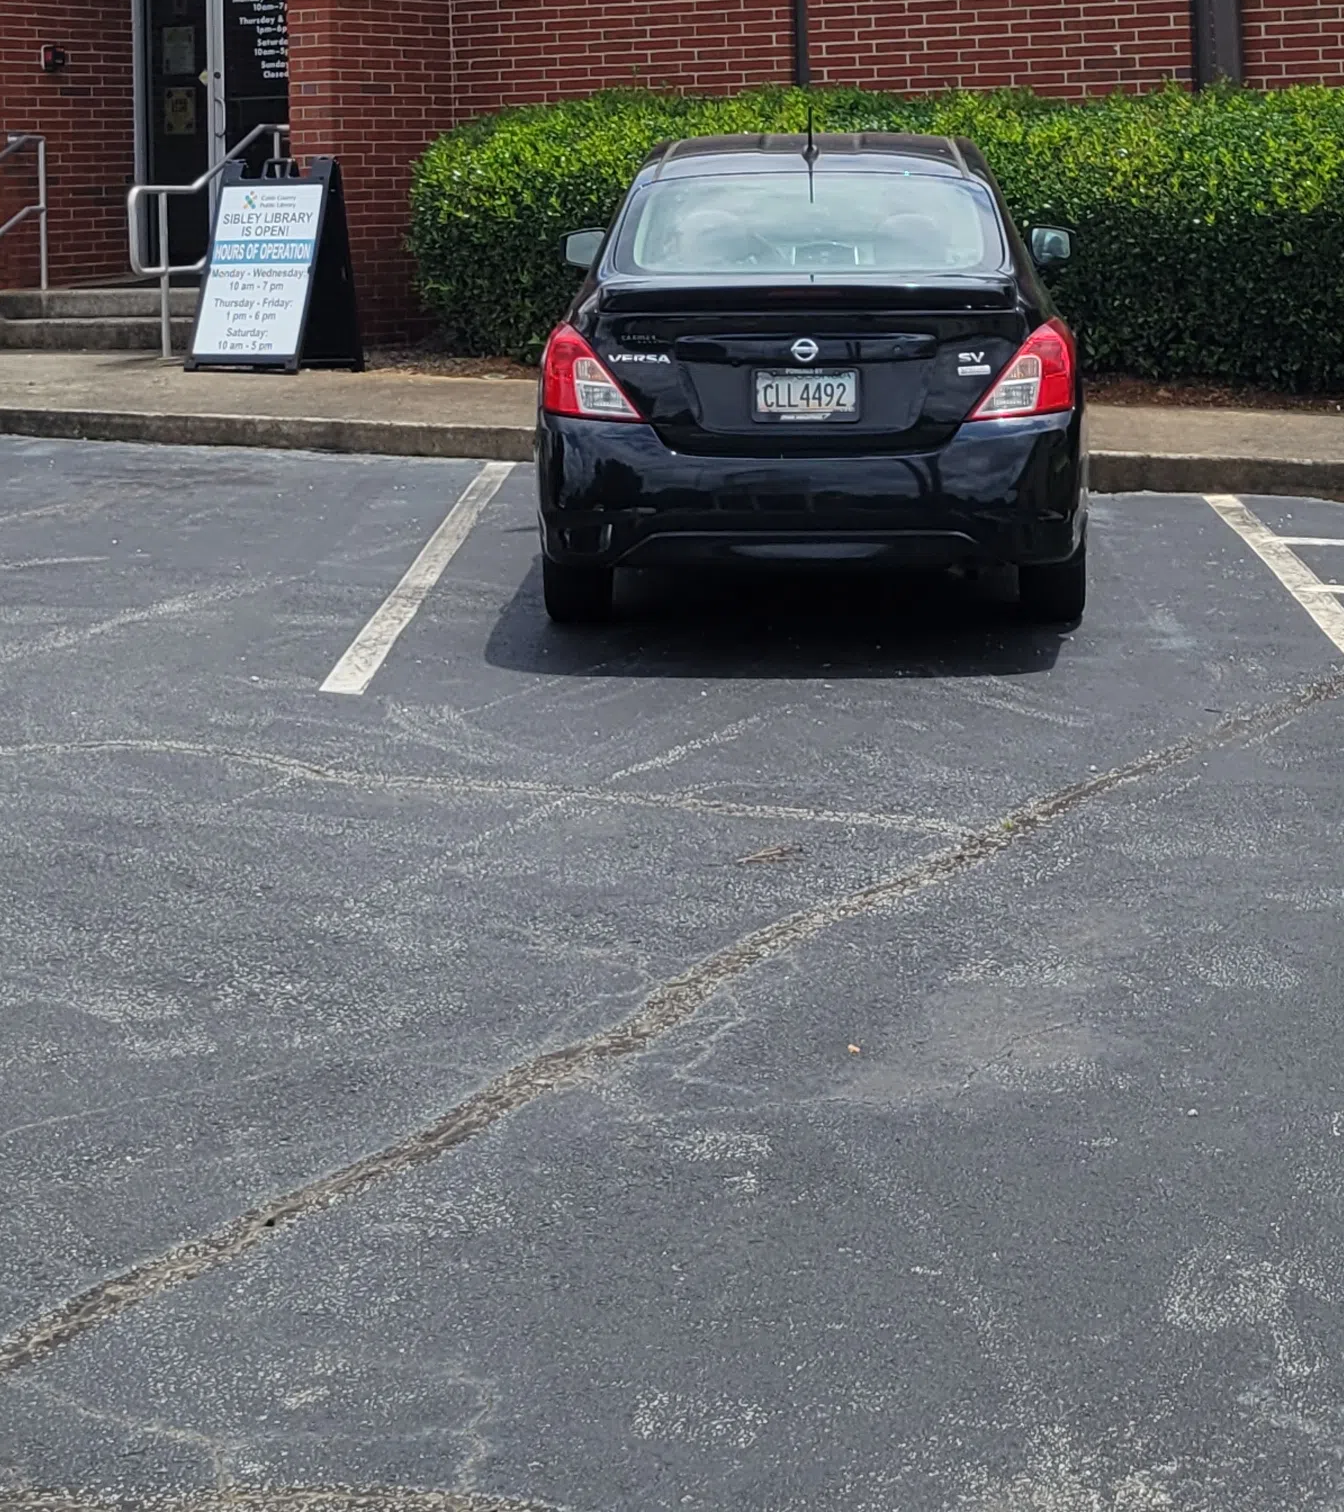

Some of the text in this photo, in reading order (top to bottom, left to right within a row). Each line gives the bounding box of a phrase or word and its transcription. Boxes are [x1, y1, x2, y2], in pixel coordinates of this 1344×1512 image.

[239, 16, 275, 25] Thursday
[223, 211, 313, 224] SIBLEY LIBRARY
[241, 225, 289, 237] IS OPEN!
[215, 242, 311, 260] HOURS OF OPERATION
[212, 269, 245, 280] Monday
[230, 281, 240, 291] 10
[269, 283, 284, 292] pm
[214, 298, 254, 309] Thursday
[232, 313, 246, 323] pm
[261, 313, 276, 323] pm
[218, 341, 228, 349] 10
[258, 342, 273, 350] pm
[608, 354, 671, 364] VERSA
[958, 351, 985, 363] SV
[763, 382, 847, 408] CLL4492
